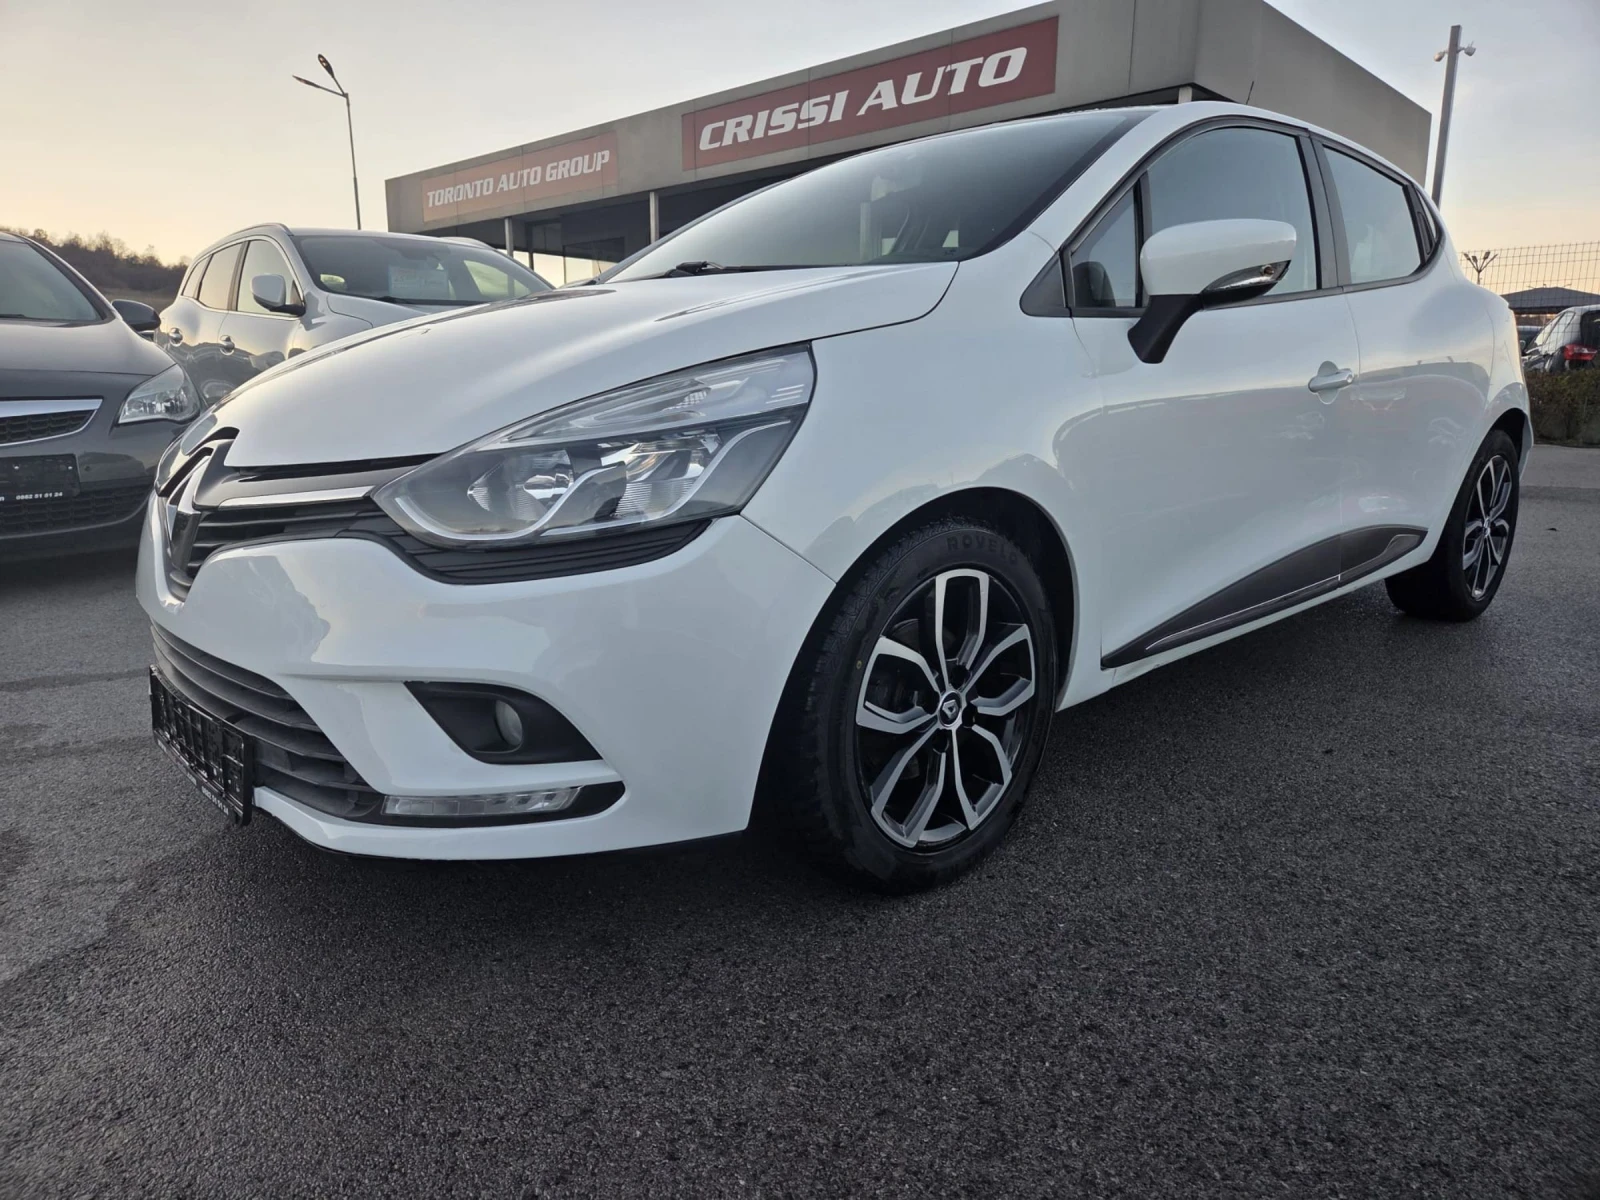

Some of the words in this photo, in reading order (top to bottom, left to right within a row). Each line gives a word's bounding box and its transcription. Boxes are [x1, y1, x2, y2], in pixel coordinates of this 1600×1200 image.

[699, 90, 849, 151] CRISSI
[856, 47, 1028, 117] AUTO
[427, 177, 494, 208] TORONTO
[496, 165, 542, 193] AUTO
[545, 150, 610, 182] GROUP
